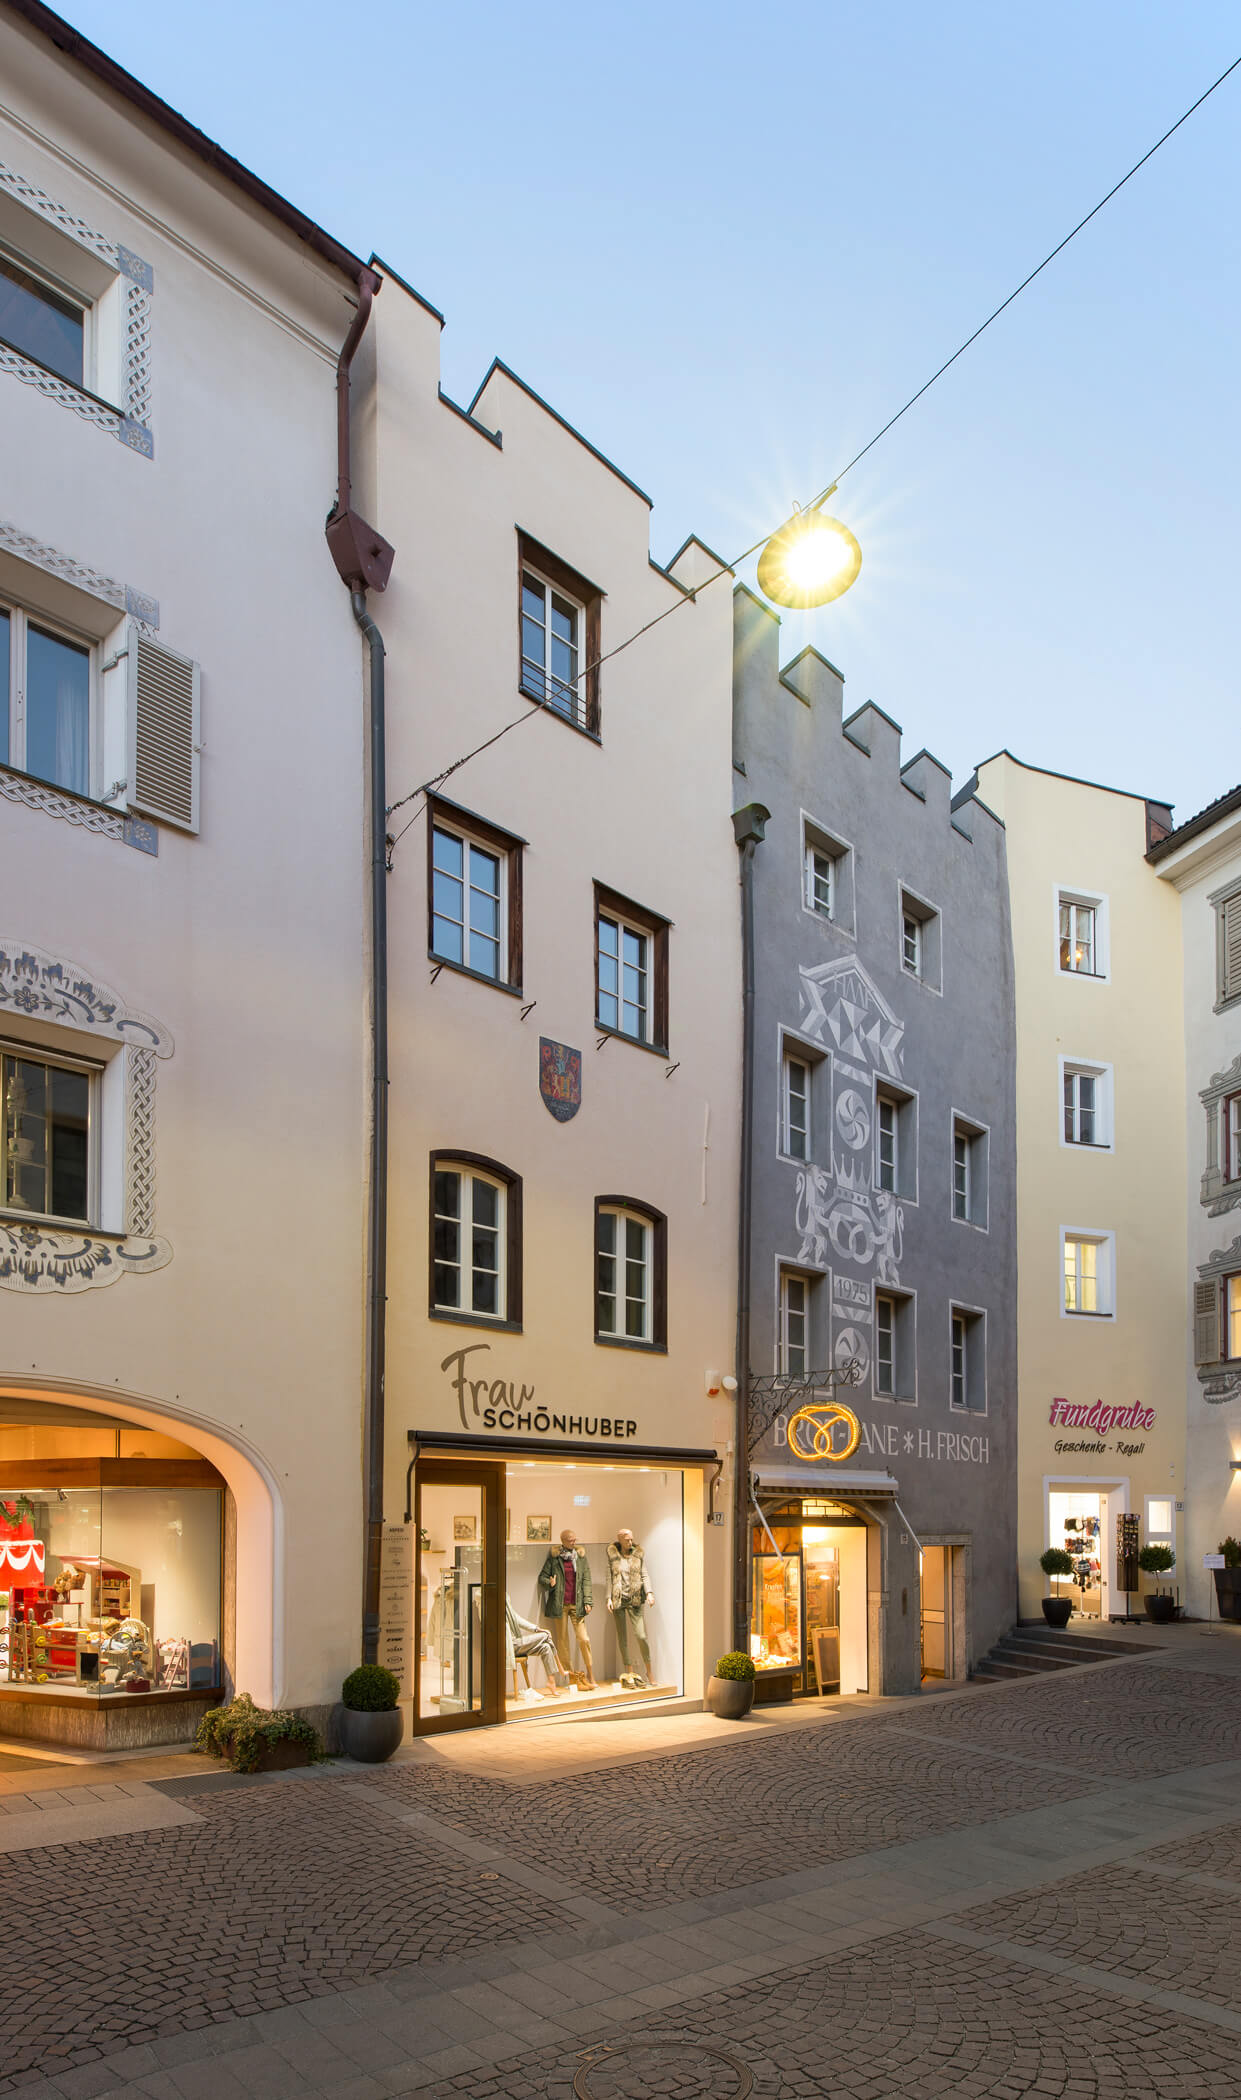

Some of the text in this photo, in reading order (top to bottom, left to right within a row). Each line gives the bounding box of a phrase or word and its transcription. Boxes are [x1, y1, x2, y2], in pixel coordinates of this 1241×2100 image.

[838, 1278, 869, 1305] 1975
[441, 1344, 535, 1430] Frau
[1049, 1397, 1156, 1435] Fundgrube
[773, 1414, 899, 1457] BROT-ANE
[937, 1431, 990, 1464] FRISCH
[1054, 1440, 1106, 1455] Geschenke
[1116, 1441, 1146, 1457] Regali
